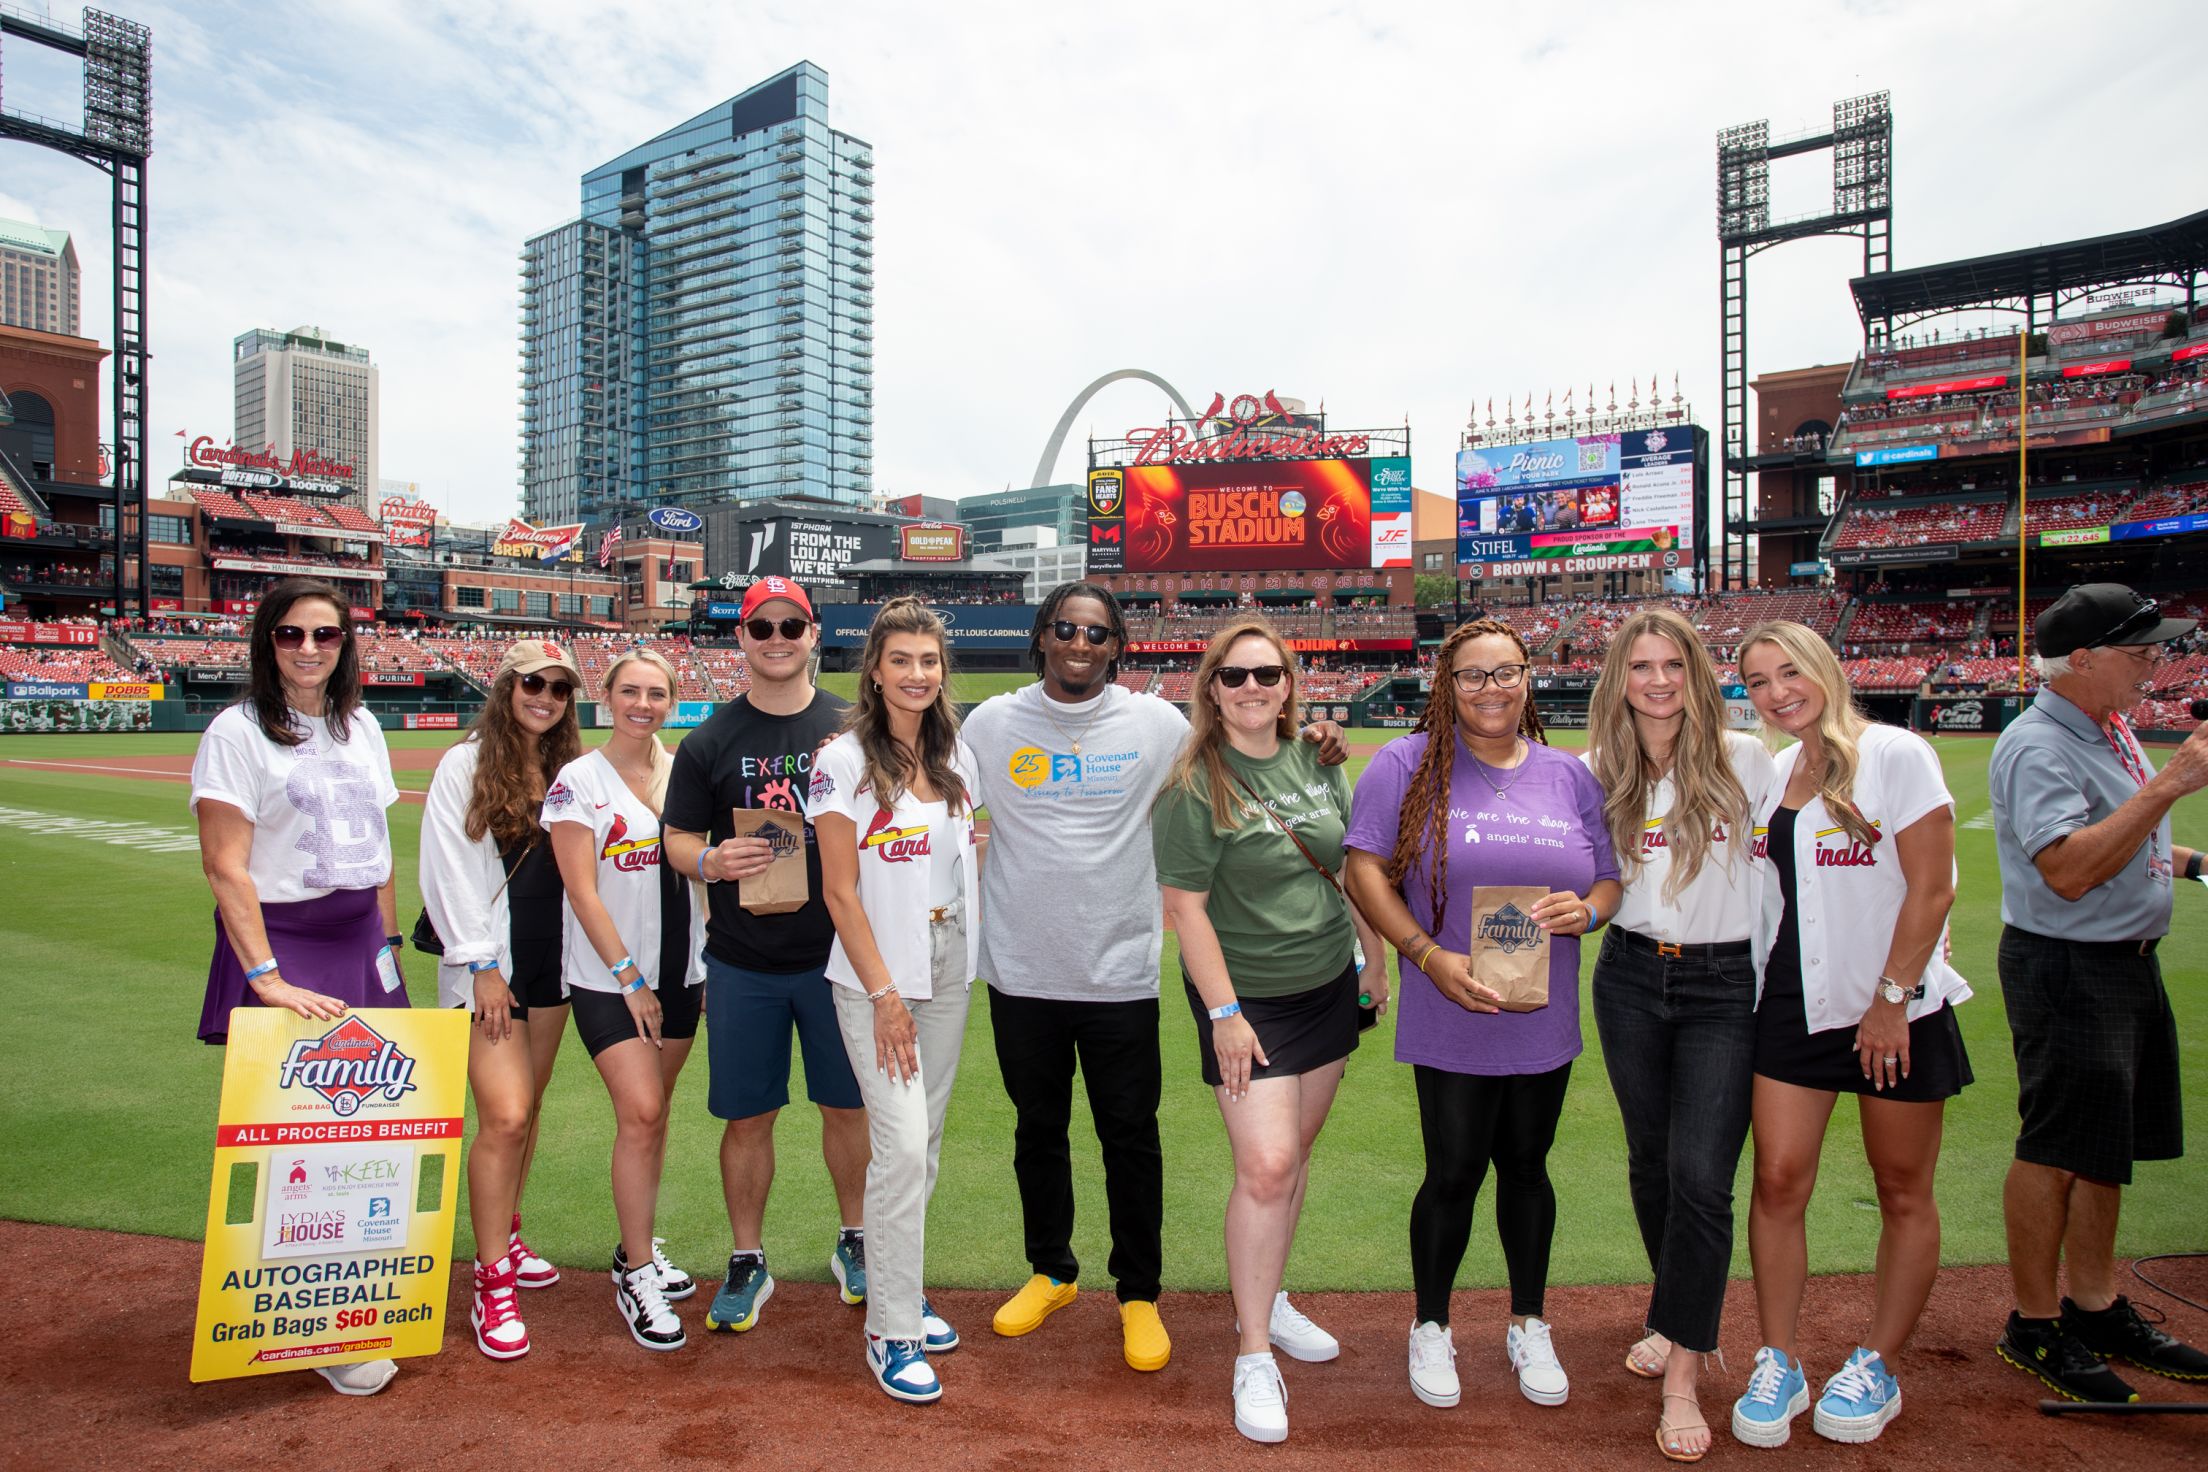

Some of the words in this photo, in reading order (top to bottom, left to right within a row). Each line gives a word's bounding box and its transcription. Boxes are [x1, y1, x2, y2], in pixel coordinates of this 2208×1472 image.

[2087, 287, 2156, 304] BUDWEISER
[2095, 314, 2167, 331] BUDWEISER
[1481, 424, 1545, 443] WORLD
[1549, 410, 1668, 434] CHAMPIONS
[1125, 425, 1369, 466] Budweiser
[190, 435, 281, 471] Cardinals
[279, 448, 353, 479] Nation
[1509, 452, 1565, 473] Picnic
[1882, 449, 1932, 461] @cardinals
[222, 469, 272, 485] HOFFMANN
[1521, 472, 1540, 480] YOUR
[289, 479, 340, 494] ROOFTOP
[991, 496, 1026, 506] POLSINELLI
[1188, 491, 1279, 519] BUSCH
[379, 496, 438, 527] Bally
[660, 509, 693, 528] Ford
[1188, 517, 1305, 544] STADIUM
[1575, 534, 1604, 542] SPONSOR
[790, 531, 832, 549] FROM
[834, 535, 861, 550] THE
[910, 536, 928, 545] GOLD
[935, 536, 953, 545] PEAK
[1471, 540, 1517, 556] STIFEL
[493, 542, 532, 559] BREW
[790, 547, 818, 561] LOU
[820, 549, 852, 562] AND
[1572, 543, 1607, 555] Cardinals
[1492, 561, 1547, 577] BROWN
[1551, 563, 1561, 573] &
[1565, 554, 1651, 572] CROUPPEN
[1840, 555, 1861, 563] Mercy
[271, 564, 289, 572] HALL
[295, 566, 313, 574] FAME
[790, 560, 835, 575] WE'RE
[1124, 579, 1130, 591] 1
[1135, 579, 1144, 591] 2
[1151, 579, 1159, 591] 6
[1165, 579, 1174, 591] 9
[1181, 579, 1193, 591] 10
[1200, 579, 1213, 591] 14
[1220, 579, 1234, 591] 17
[1240, 578, 1256, 590] 20
[1265, 578, 1281, 590] 23
[1287, 578, 1304, 590] 24
[1311, 576, 1328, 588] 42
[1335, 576, 1352, 588] 45
[1357, 576, 1374, 588] 85
[835, 629, 869, 637] OFFICIAL
[988, 629, 1030, 637] CARDINALS
[1286, 639, 1336, 651] ADIUM
[198, 672, 220, 680] Mercy
[28, 686, 80, 697] Ballpark
[105, 685, 150, 694] DOBBS
[1383, 719, 1406, 727] BUSCH
[1014, 754, 1046, 774] 25
[1085, 751, 1140, 764] Covenant
[1086, 763, 1121, 774] House
[1279, 792, 1301, 806] the
[1285, 813, 1306, 829] gels'
[1476, 811, 1500, 822] are
[1506, 812, 1531, 825] the
[1486, 832, 1530, 844] angels'
[1533, 836, 1565, 849] arms
[1478, 914, 1544, 947] Family
[327, 1033, 377, 1051] Cardinals
[280, 1040, 418, 1101] Family
[236, 1128, 271, 1143] ALL
[277, 1124, 373, 1141] PROCEEDS
[379, 1122, 449, 1137] BENEFIT
[341, 1159, 400, 1184] KEEN
[284, 1193, 308, 1201] arms
[281, 1209, 346, 1226] LYDIA'S
[357, 1218, 400, 1228] Covenant
[279, 1222, 345, 1243] HOUSE
[362, 1235, 393, 1243] Missouri
[363, 1227, 392, 1236] House
[221, 1255, 435, 1291] AUTOGRAPHED
[254, 1282, 401, 1313] BASEBALL
[212, 1319, 266, 1343] Grab
[273, 1315, 328, 1338] Bags
[335, 1307, 378, 1332] $60
[383, 1303, 433, 1325] each
[261, 1338, 392, 1361] cardinals.com/grabbags
